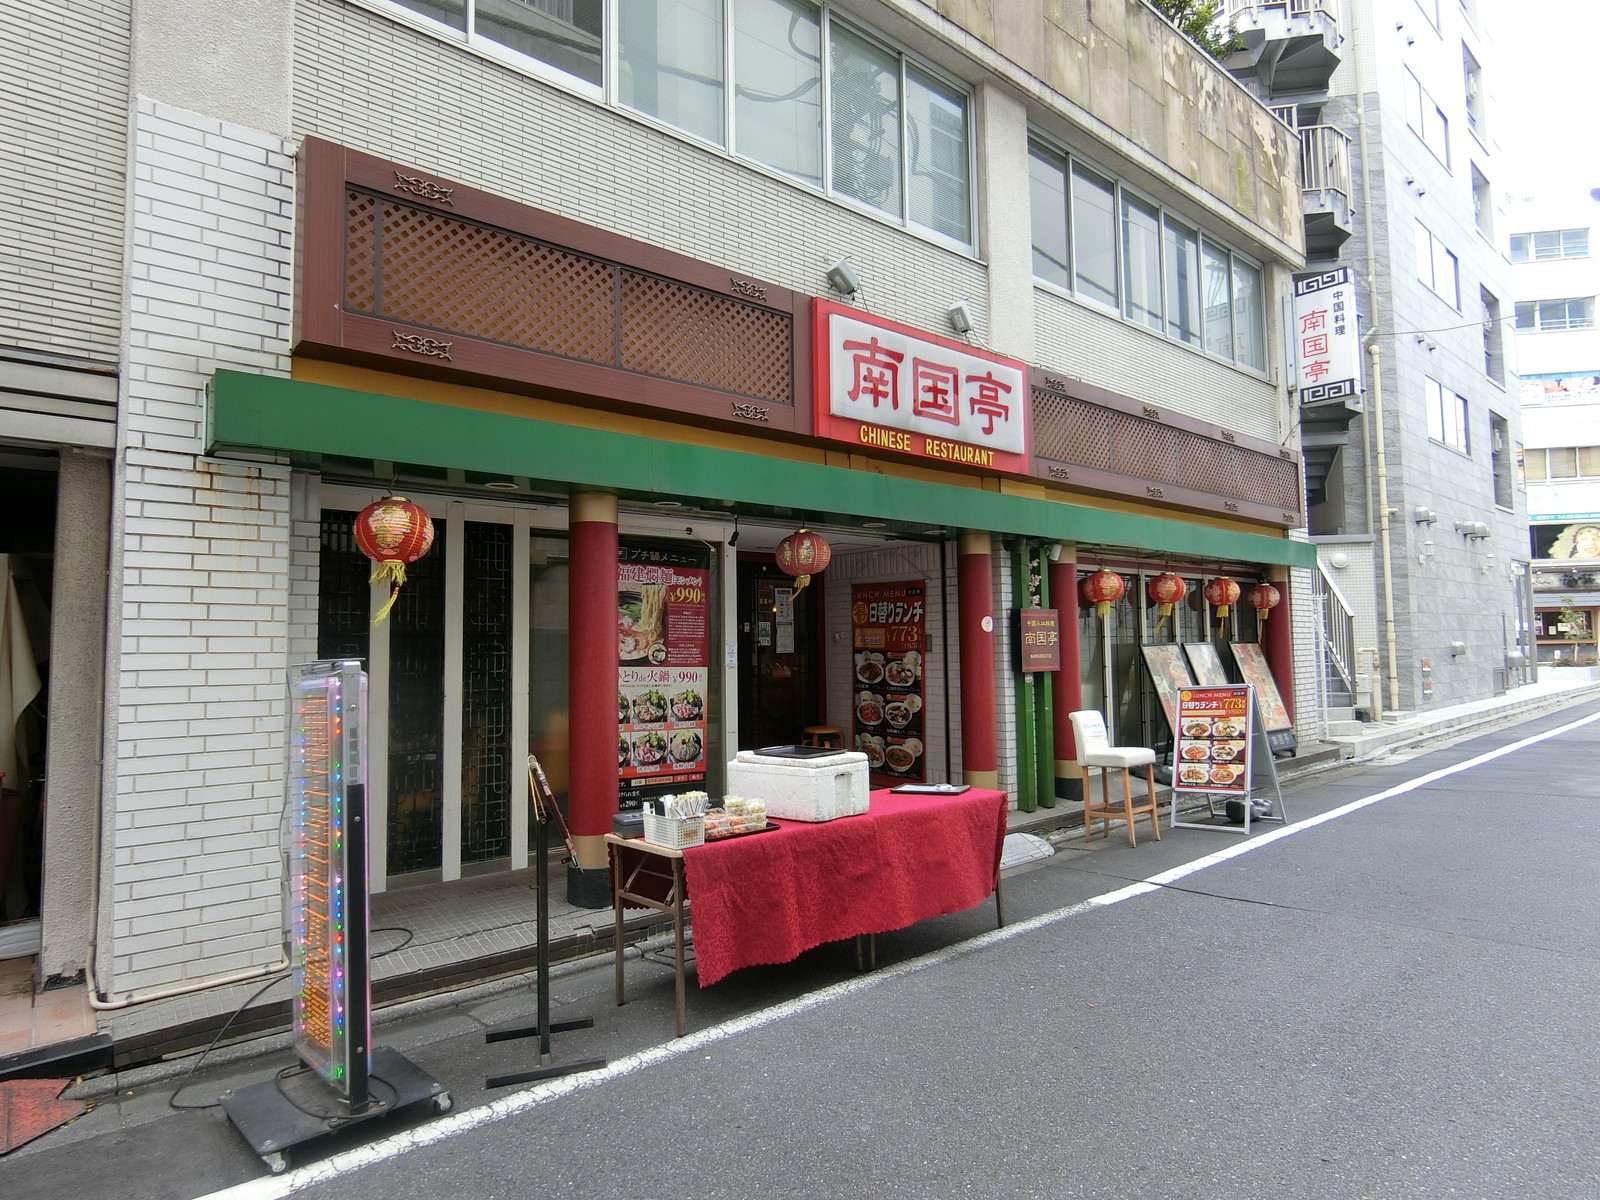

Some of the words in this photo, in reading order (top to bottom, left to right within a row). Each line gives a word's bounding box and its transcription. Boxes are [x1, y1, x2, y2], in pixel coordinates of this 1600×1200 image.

[1333, 290, 1346, 336] 中国料理
[1299, 309, 1331, 383] 南国亭
[842, 336, 1013, 436] 南国亭
[859, 424, 911, 452] CHINESE
[925, 438, 995, 467] RESTAURANT
[631, 548, 698, 564] プチ鍋メニュー
[670, 586, 701, 604] ¥990
[883, 589, 906, 598] MENU
[869, 600, 924, 624] 日替りランチ
[886, 625, 918, 642] ¥773
[1025, 631, 1058, 646] 南国亭
[618, 669, 670, 684] とりde火鍋
[672, 670, 698, 684] ¥990
[1181, 700, 1219, 709] 日替りランチ
[1219, 698, 1241, 709] ¥773
